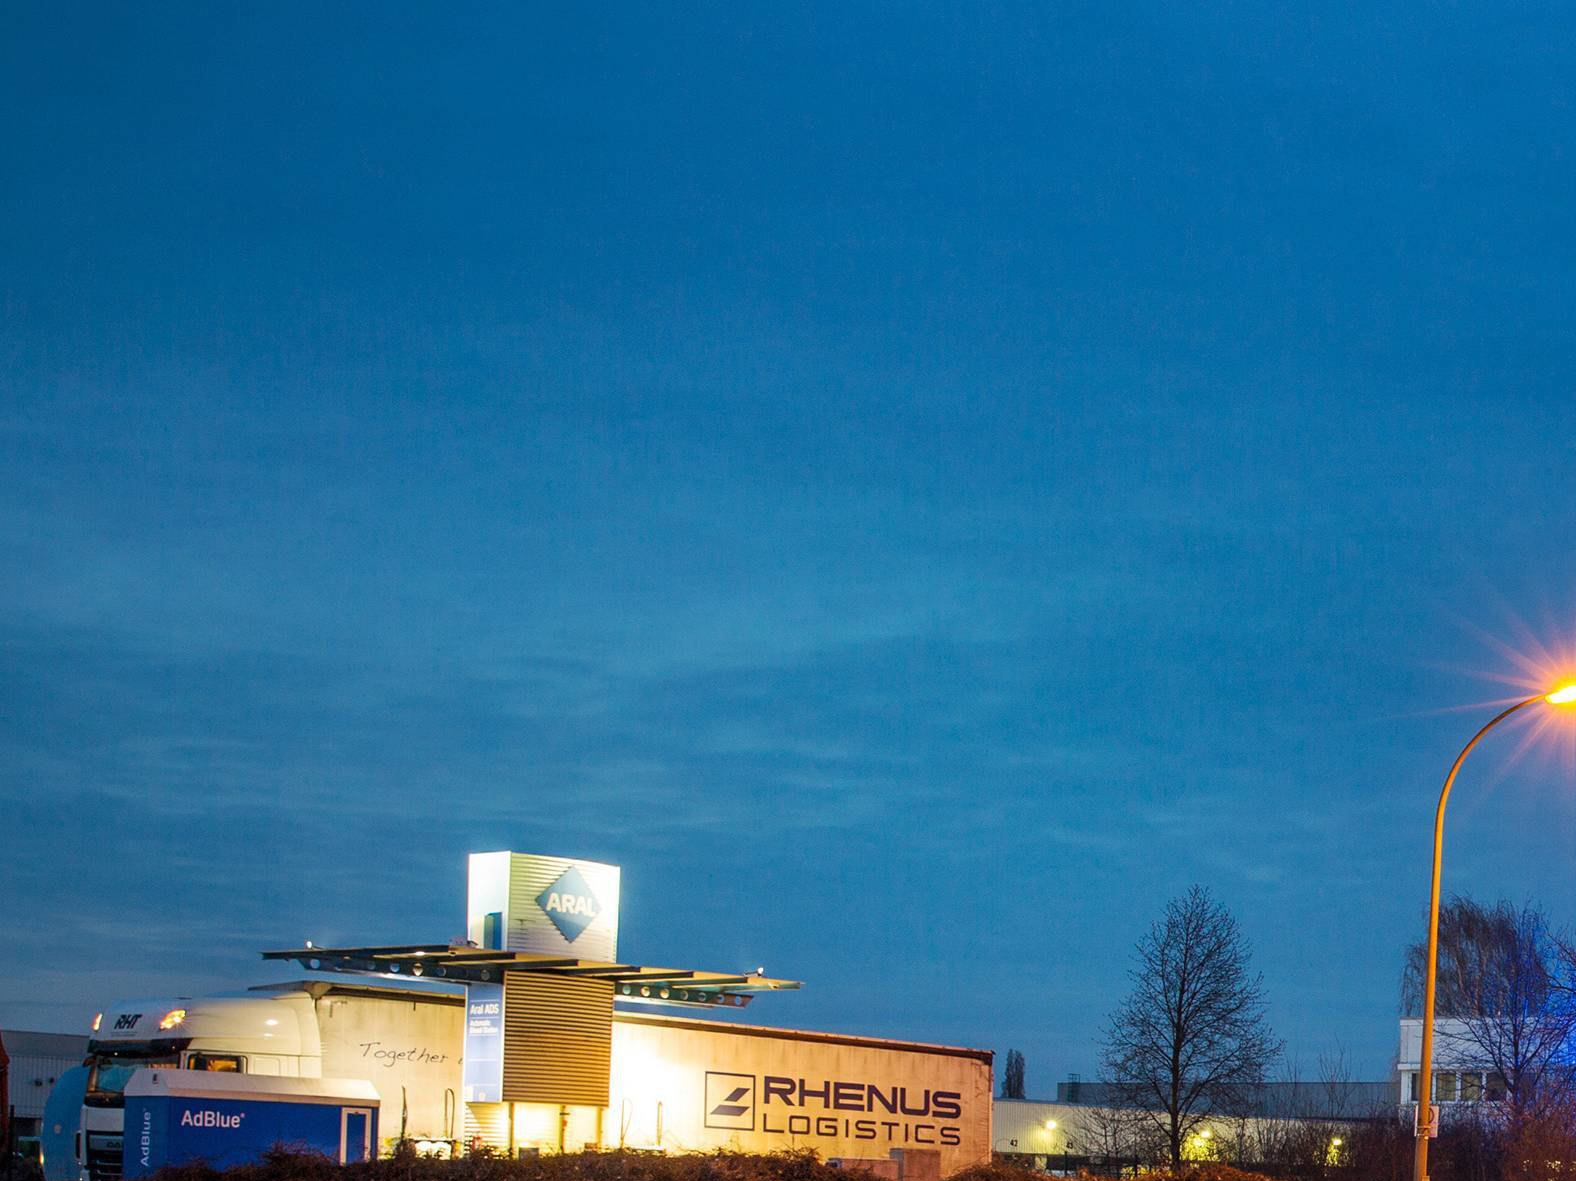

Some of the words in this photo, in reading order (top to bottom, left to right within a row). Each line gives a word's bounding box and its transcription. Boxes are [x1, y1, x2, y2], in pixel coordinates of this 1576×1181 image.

[546, 892, 596, 917] ARAL
[114, 1014, 143, 1029] RHT
[360, 1042, 448, 1067] Together
[764, 1076, 961, 1119] RHENUS
[763, 1113, 960, 1146] LOGISTICS
